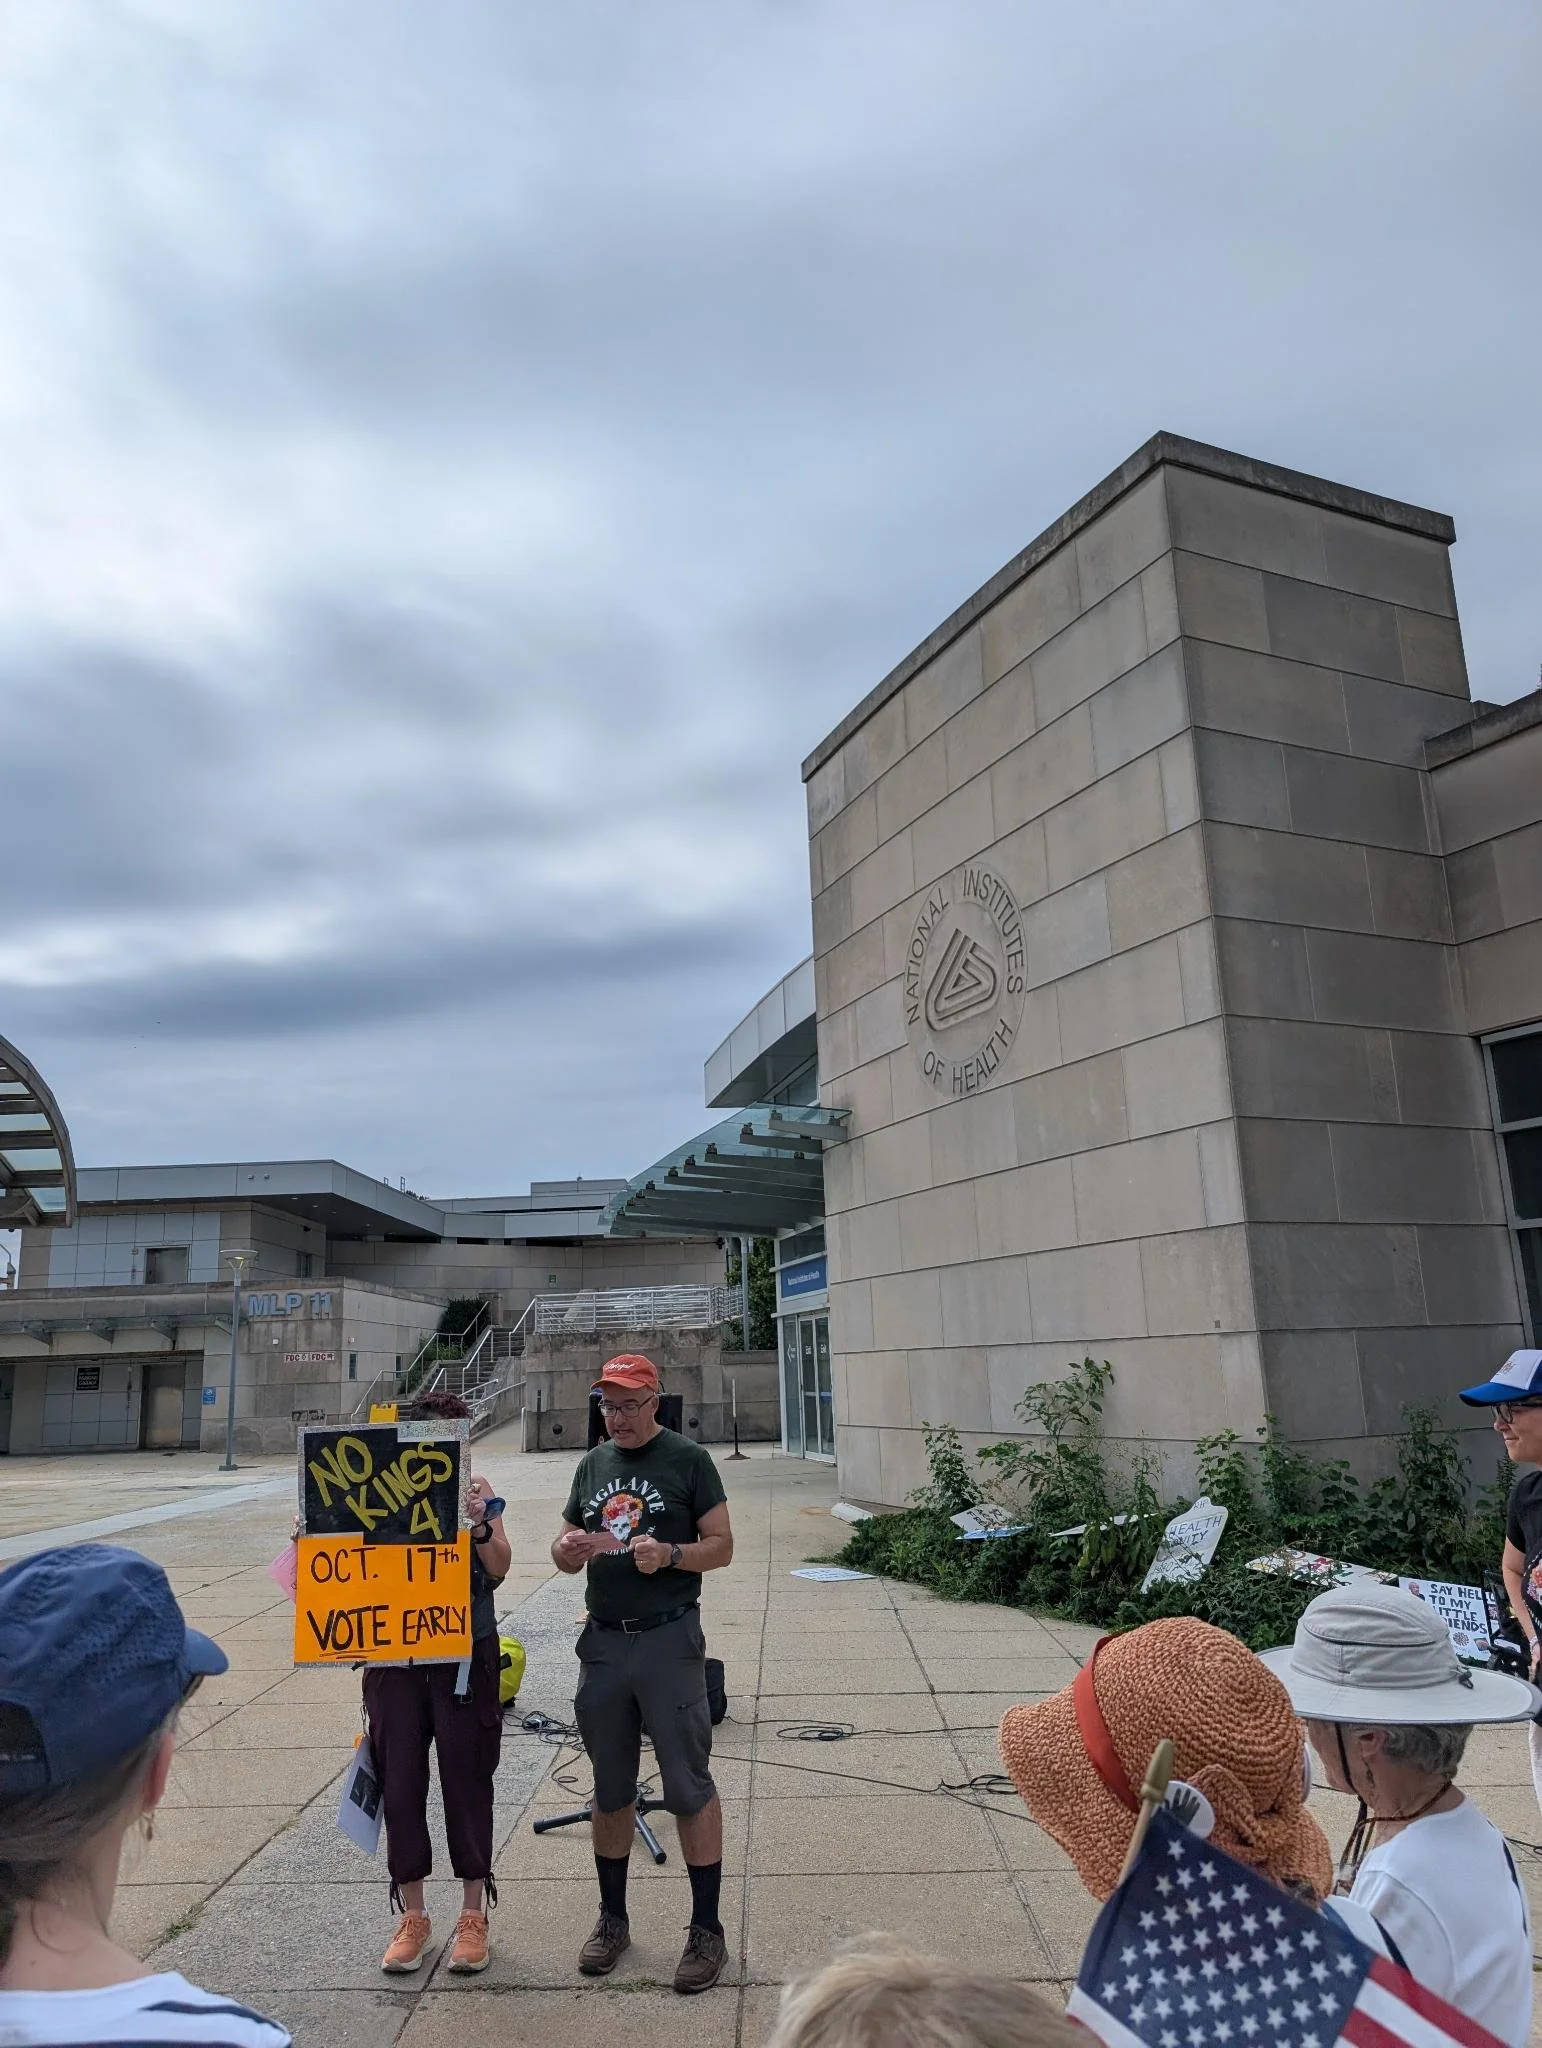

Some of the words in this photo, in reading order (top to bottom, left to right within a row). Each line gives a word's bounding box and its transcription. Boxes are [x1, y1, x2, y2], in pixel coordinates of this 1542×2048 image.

[906, 888, 949, 1025] NATIONAL
[962, 869, 1025, 995] INSTITUTES
[923, 1051, 945, 1084] OF
[952, 1018, 1013, 1094] HEALTH
[248, 1293, 302, 1316] MLP
[310, 1292, 331, 1318] 11
[308, 1437, 373, 1507] NO
[345, 1441, 453, 1532] KINGS
[584, 1477, 665, 1518] VIGILANTE
[410, 1497, 442, 1541] 4
[1170, 1515, 1222, 1536] HEALTH
[310, 1547, 379, 1583] OCT.
[407, 1547, 460, 1583] 17th
[1429, 1595, 1446, 1605] TO
[1450, 1598, 1471, 1610] MY
[1431, 1584, 1453, 1595] SAY
[306, 1604, 392, 1651] VOTE
[402, 1605, 467, 1646] EARLY
[1433, 1606, 1477, 1621] ITTLE
